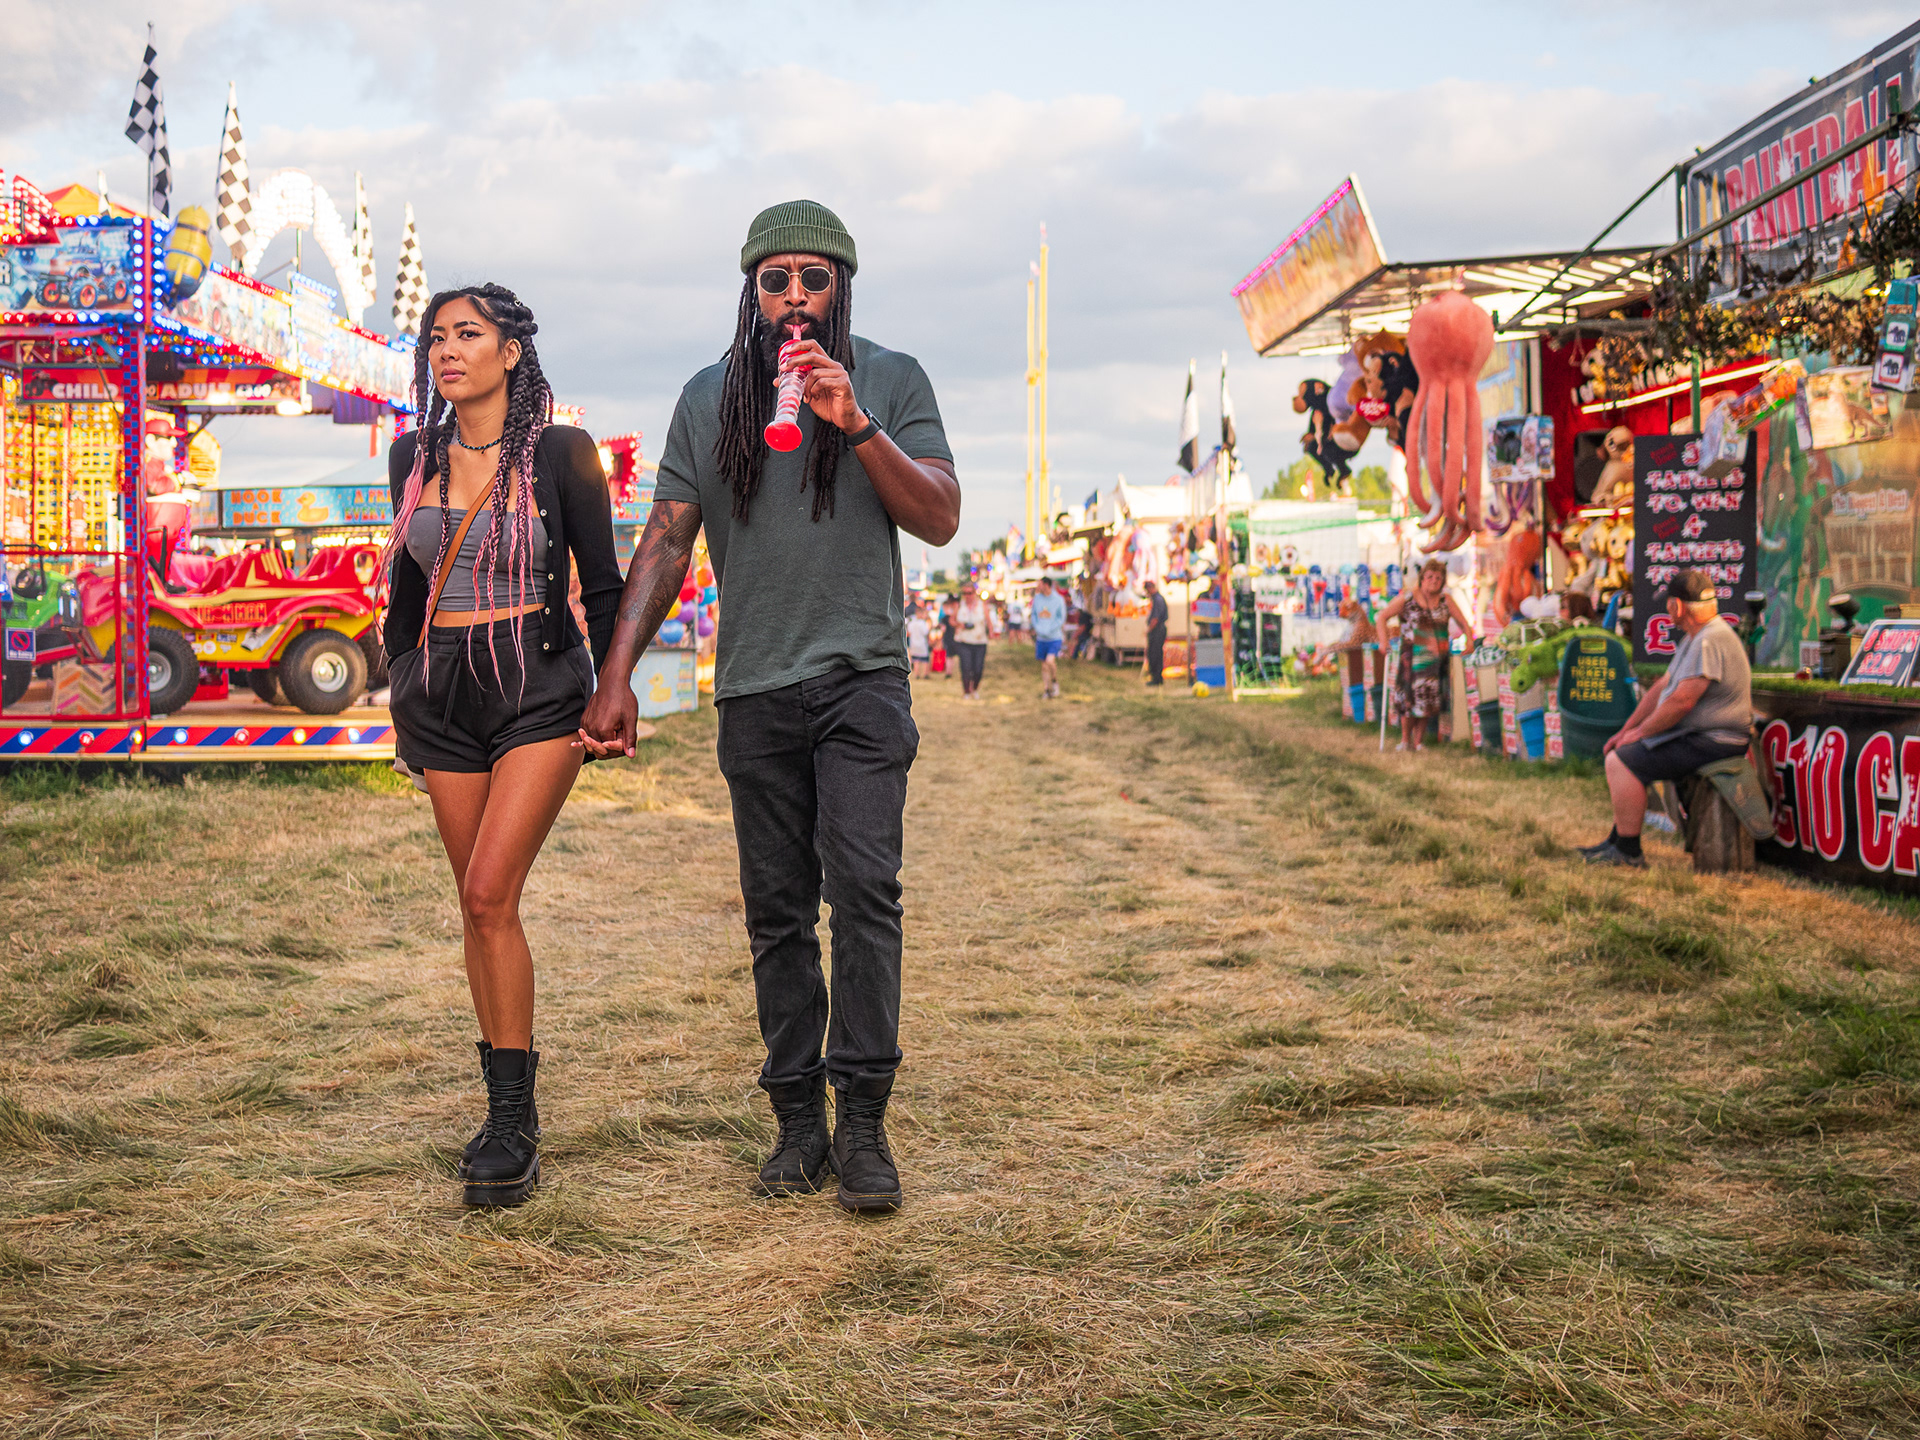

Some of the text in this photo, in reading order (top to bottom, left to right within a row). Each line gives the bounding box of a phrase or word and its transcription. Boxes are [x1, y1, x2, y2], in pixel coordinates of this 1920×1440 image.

[52, 382, 119, 399] CHILD
[231, 489, 283, 504] HOOK
[1646, 493, 1688, 513] TO
[232, 511, 282, 526] DUCK
[344, 507, 387, 522] EVERY
[1645, 540, 1746, 563] TARGETS
[1690, 563, 1744, 583] IN
[1577, 656, 1608, 667] USED
[1570, 666, 1616, 680] TICKETS
[1570, 688, 1613, 702] PLEASE
[1760, 719, 1849, 862] £10
